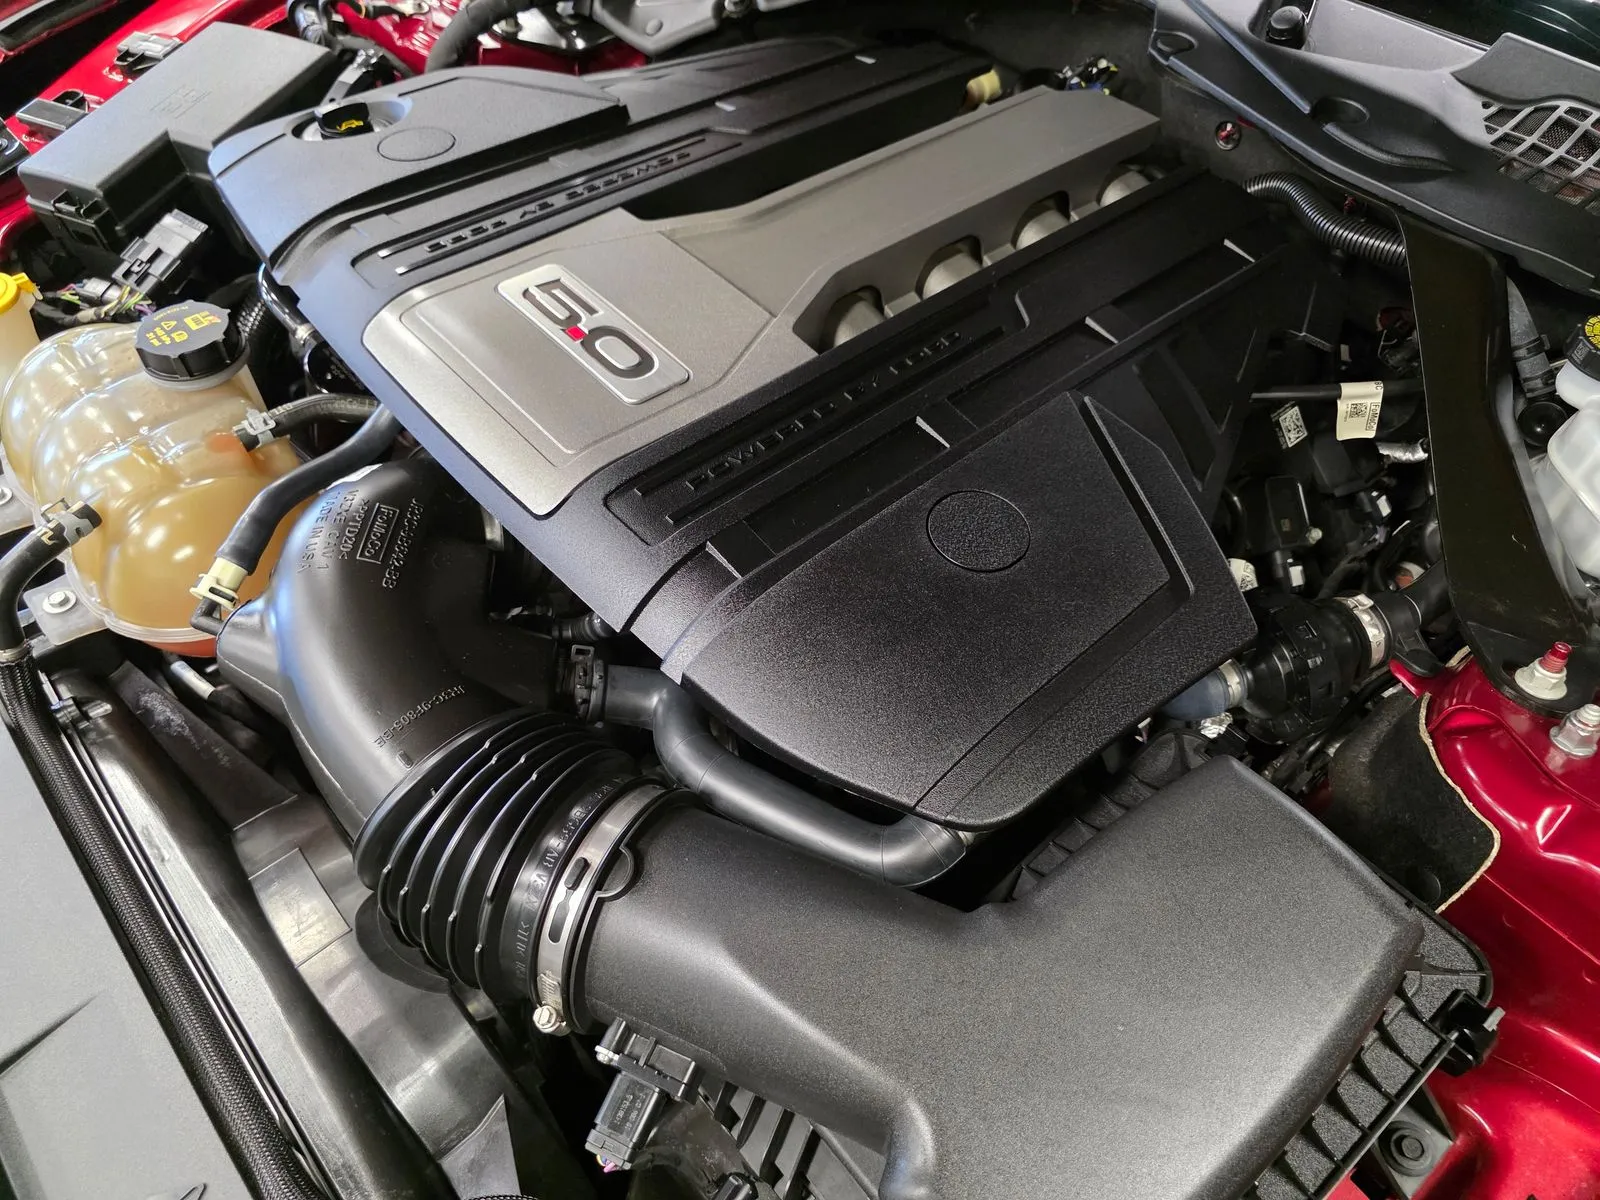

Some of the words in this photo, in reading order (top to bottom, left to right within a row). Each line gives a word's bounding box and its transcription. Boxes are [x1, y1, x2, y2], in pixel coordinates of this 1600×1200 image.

[521, 278, 658, 380] 5.0
[685, 402, 836, 491] POWERED
[843, 372, 880, 401] BY
[1367, 403, 1381, 430] FoMoCo
[308, 526, 325, 541] IN
[364, 506, 394, 557] FoMoCo
